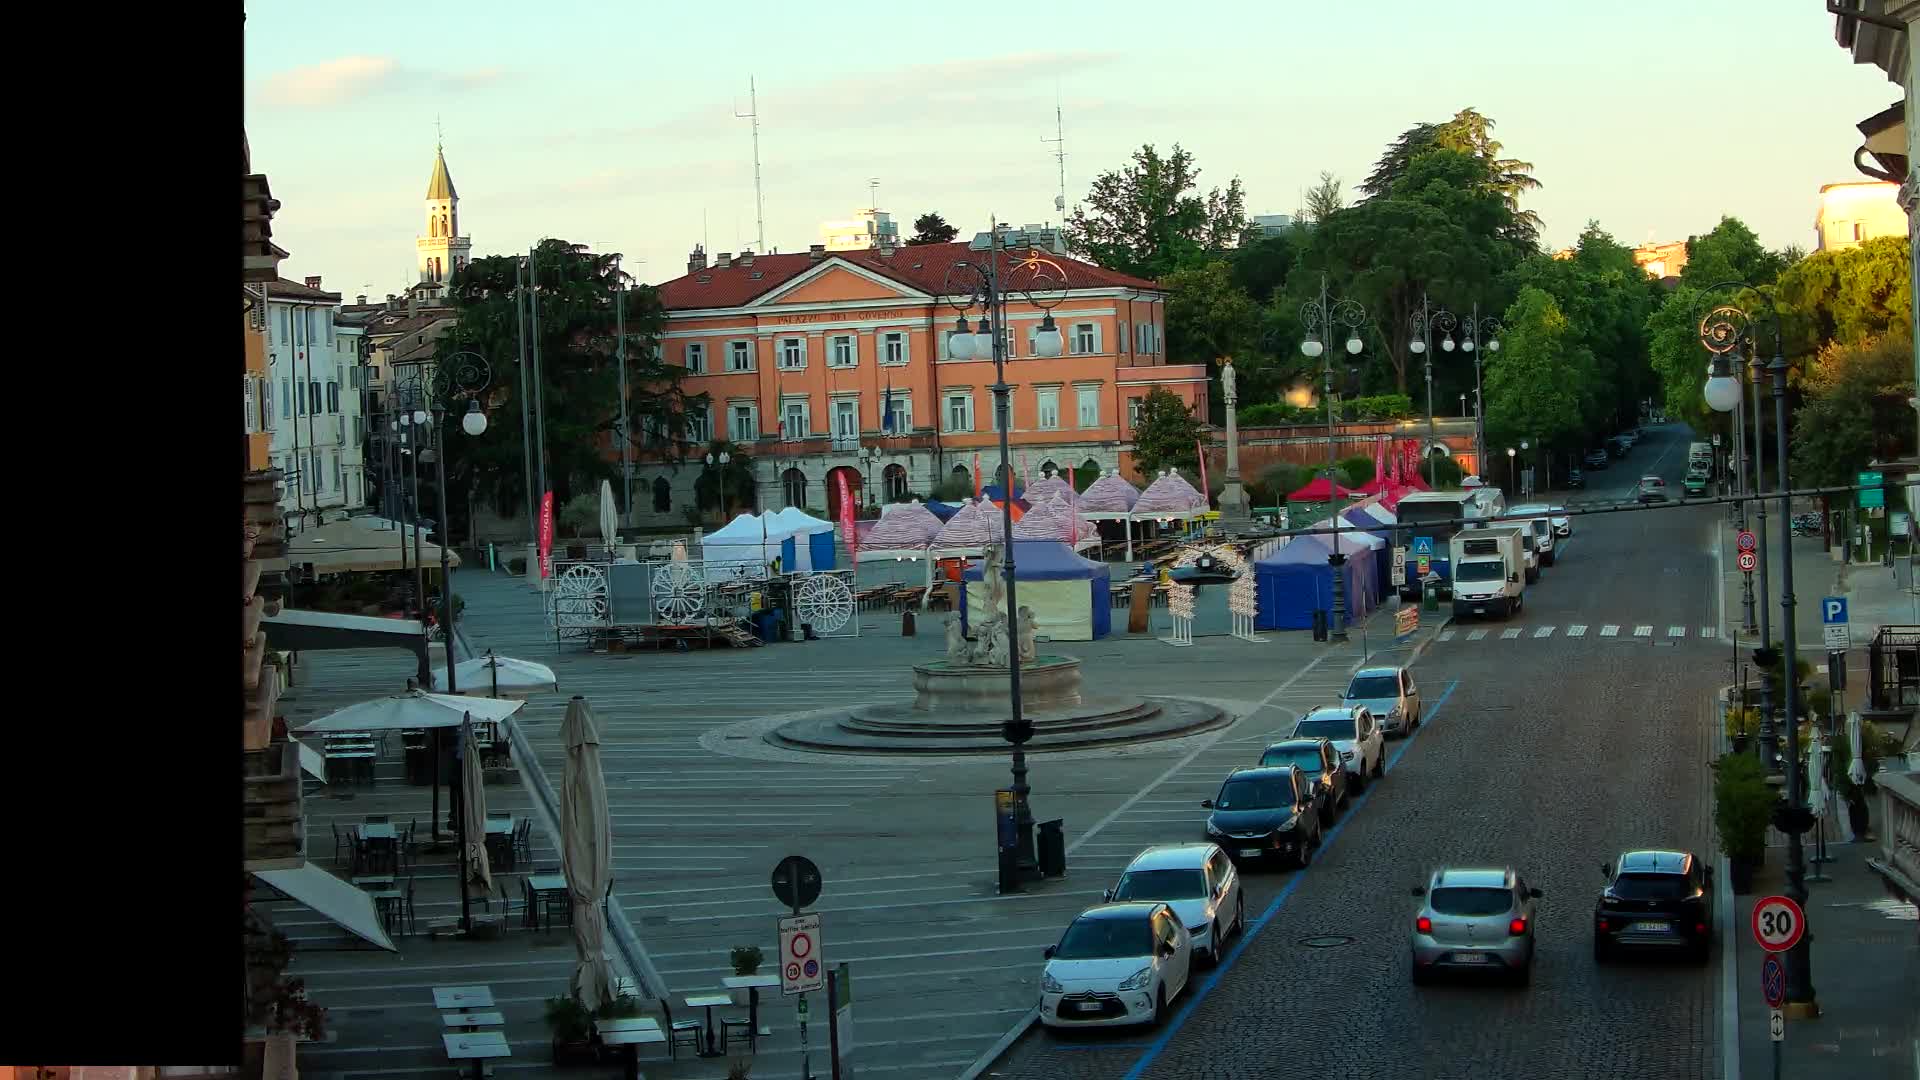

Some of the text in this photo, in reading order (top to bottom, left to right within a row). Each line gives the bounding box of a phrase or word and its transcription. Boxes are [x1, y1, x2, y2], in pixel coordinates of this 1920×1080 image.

[1742, 557, 1753, 566] 20
[1827, 601, 1842, 621] P
[1763, 911, 1792, 937] 30
[790, 968, 798, 977] 20
